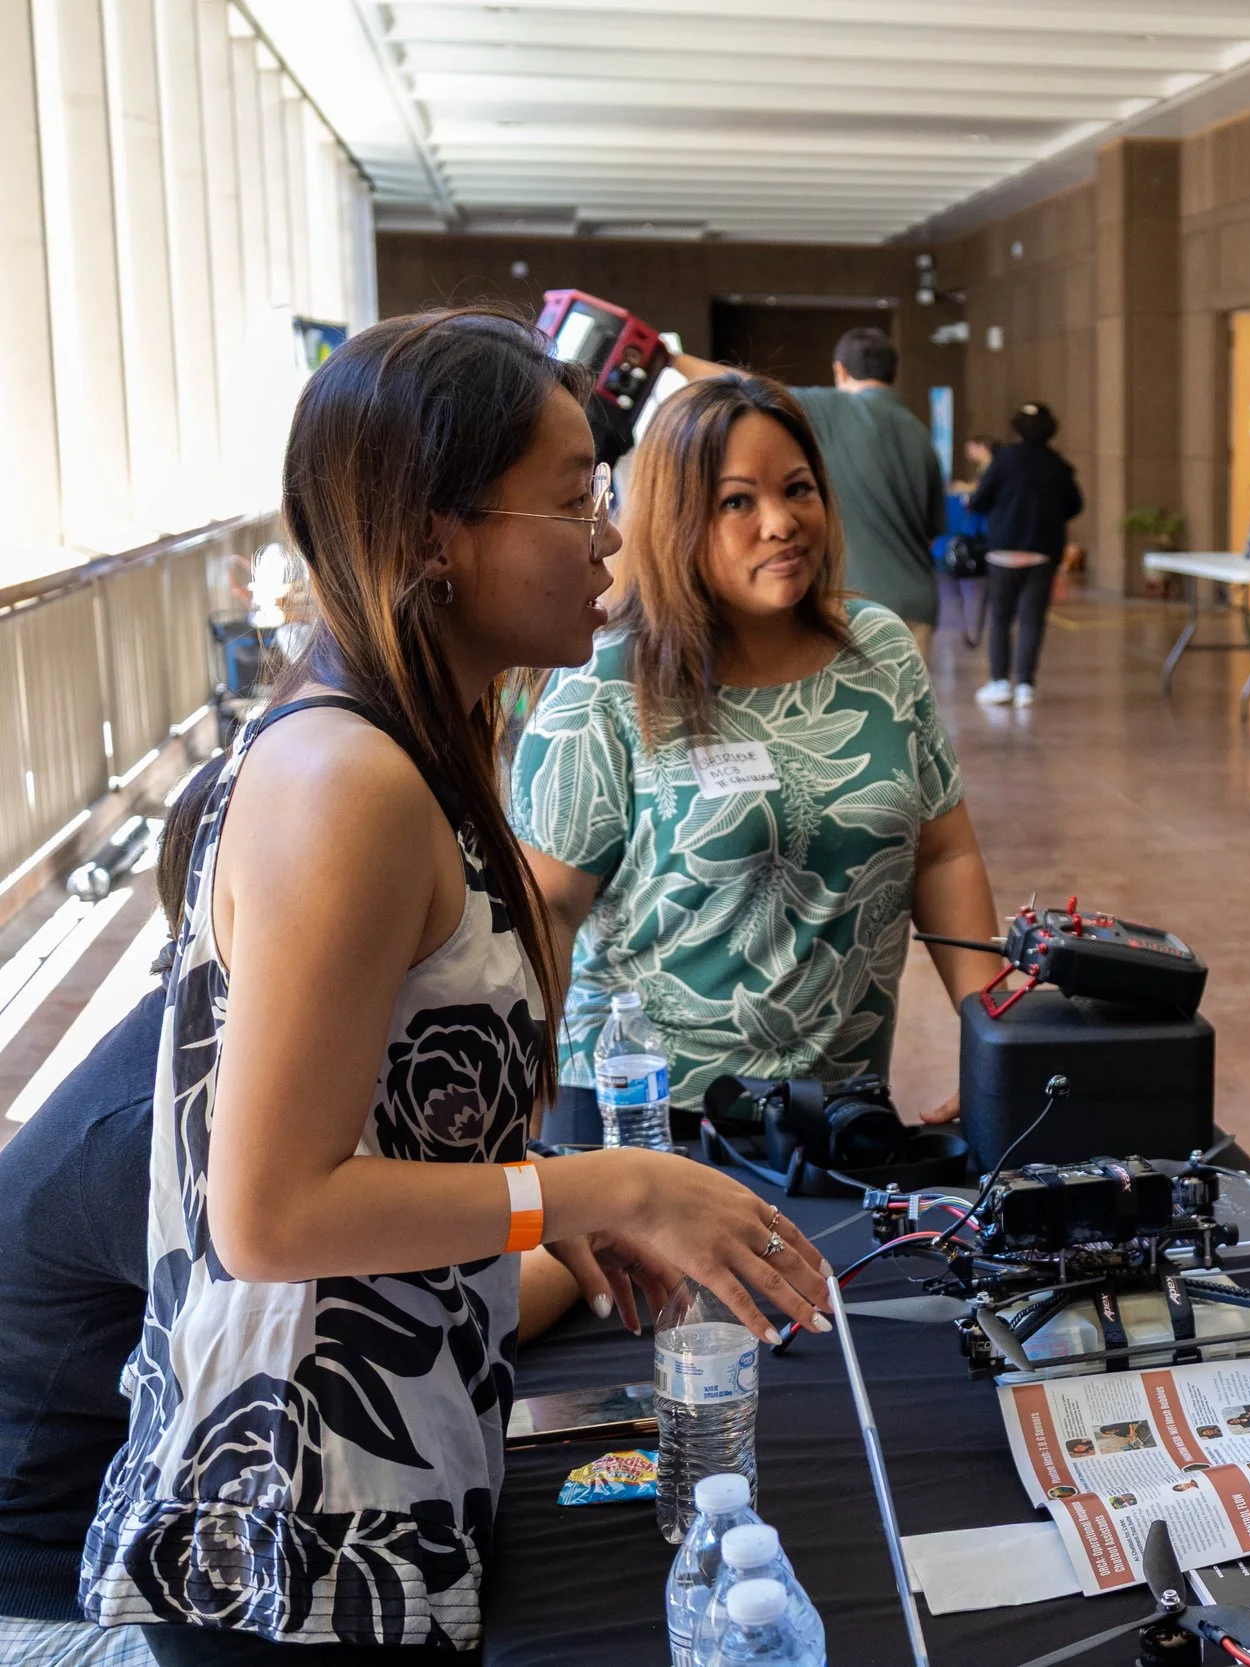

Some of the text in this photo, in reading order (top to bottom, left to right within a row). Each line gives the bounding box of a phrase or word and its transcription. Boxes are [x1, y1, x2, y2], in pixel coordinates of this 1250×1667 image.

[1165, 1275, 1182, 1305] Apex
[1101, 1292, 1115, 1322] Apex
[1154, 1385, 1170, 1411] Bubbles
[1029, 1410, 1045, 1437] Sensors
[1162, 1408, 1174, 1424] Mesh
[1231, 1492, 1248, 1510] FLOW
[1078, 1519, 1104, 1557] Operational
[1093, 1513, 1126, 1573] Chatbot Assistants
[1129, 1525, 1137, 1536] Tool
[1125, 1538, 1137, 1556] Chatbot
[1093, 1555, 1110, 1577] ORCA:
